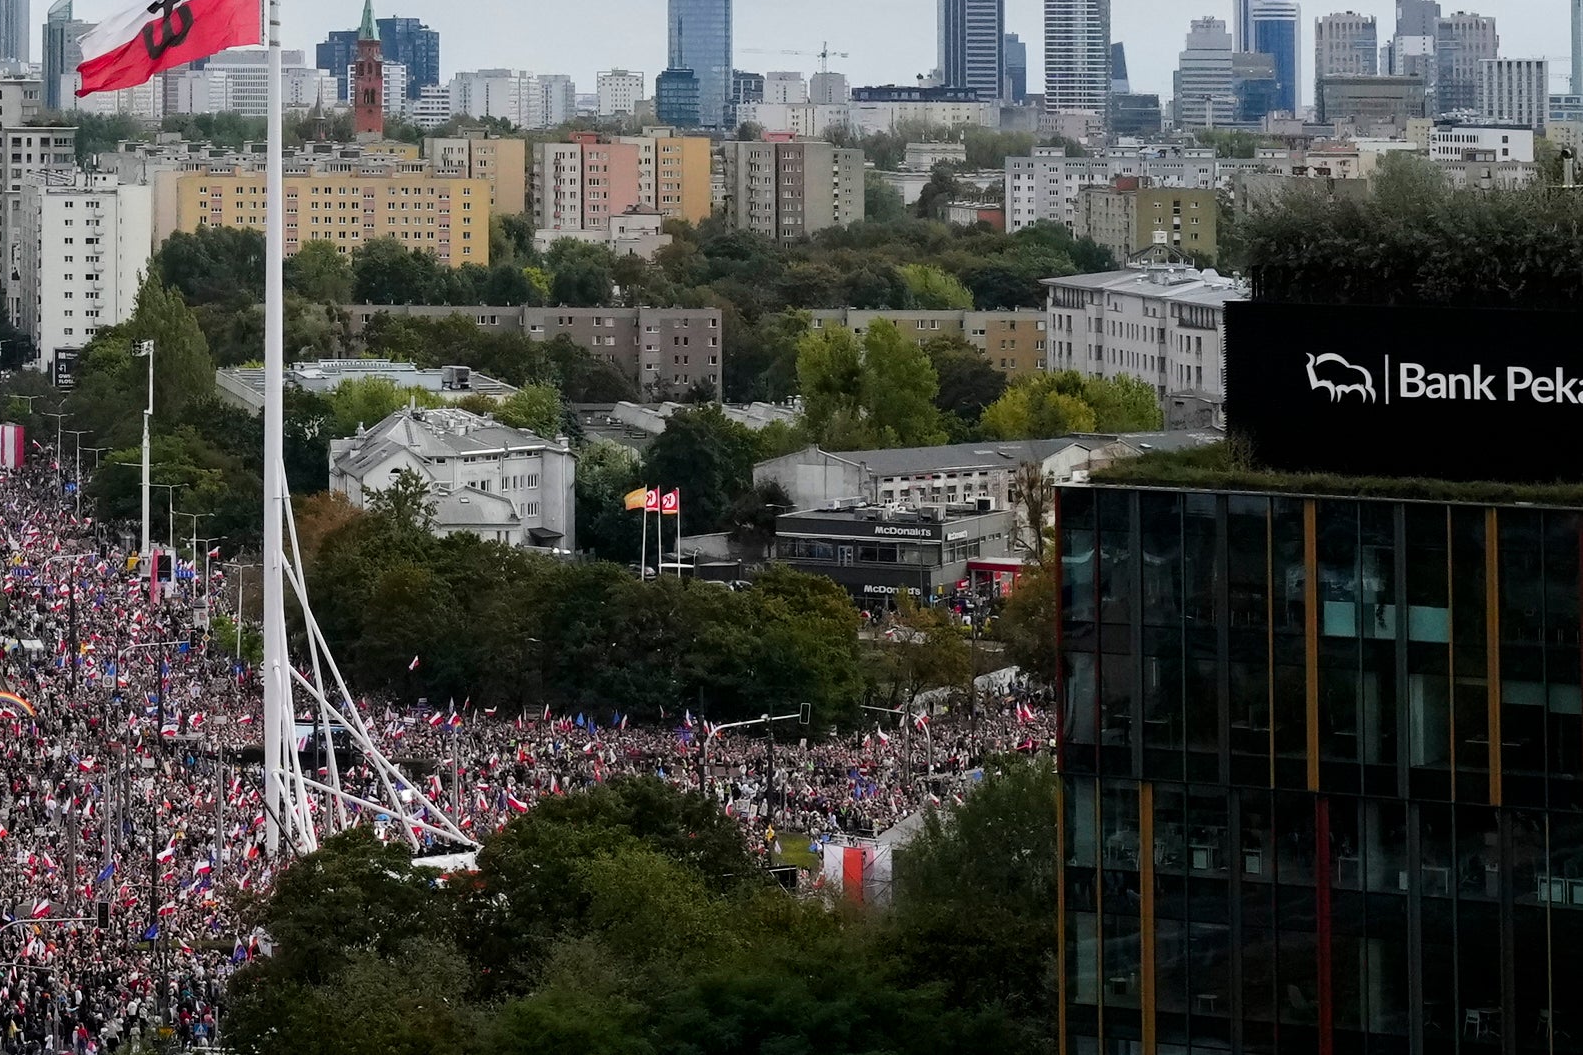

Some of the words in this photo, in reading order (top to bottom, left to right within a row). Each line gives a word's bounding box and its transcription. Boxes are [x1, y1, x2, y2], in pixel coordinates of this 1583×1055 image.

[1399, 362, 1497, 401] Bank
[1507, 366, 1583, 404] Pek
[863, 584, 921, 595] McDond's
